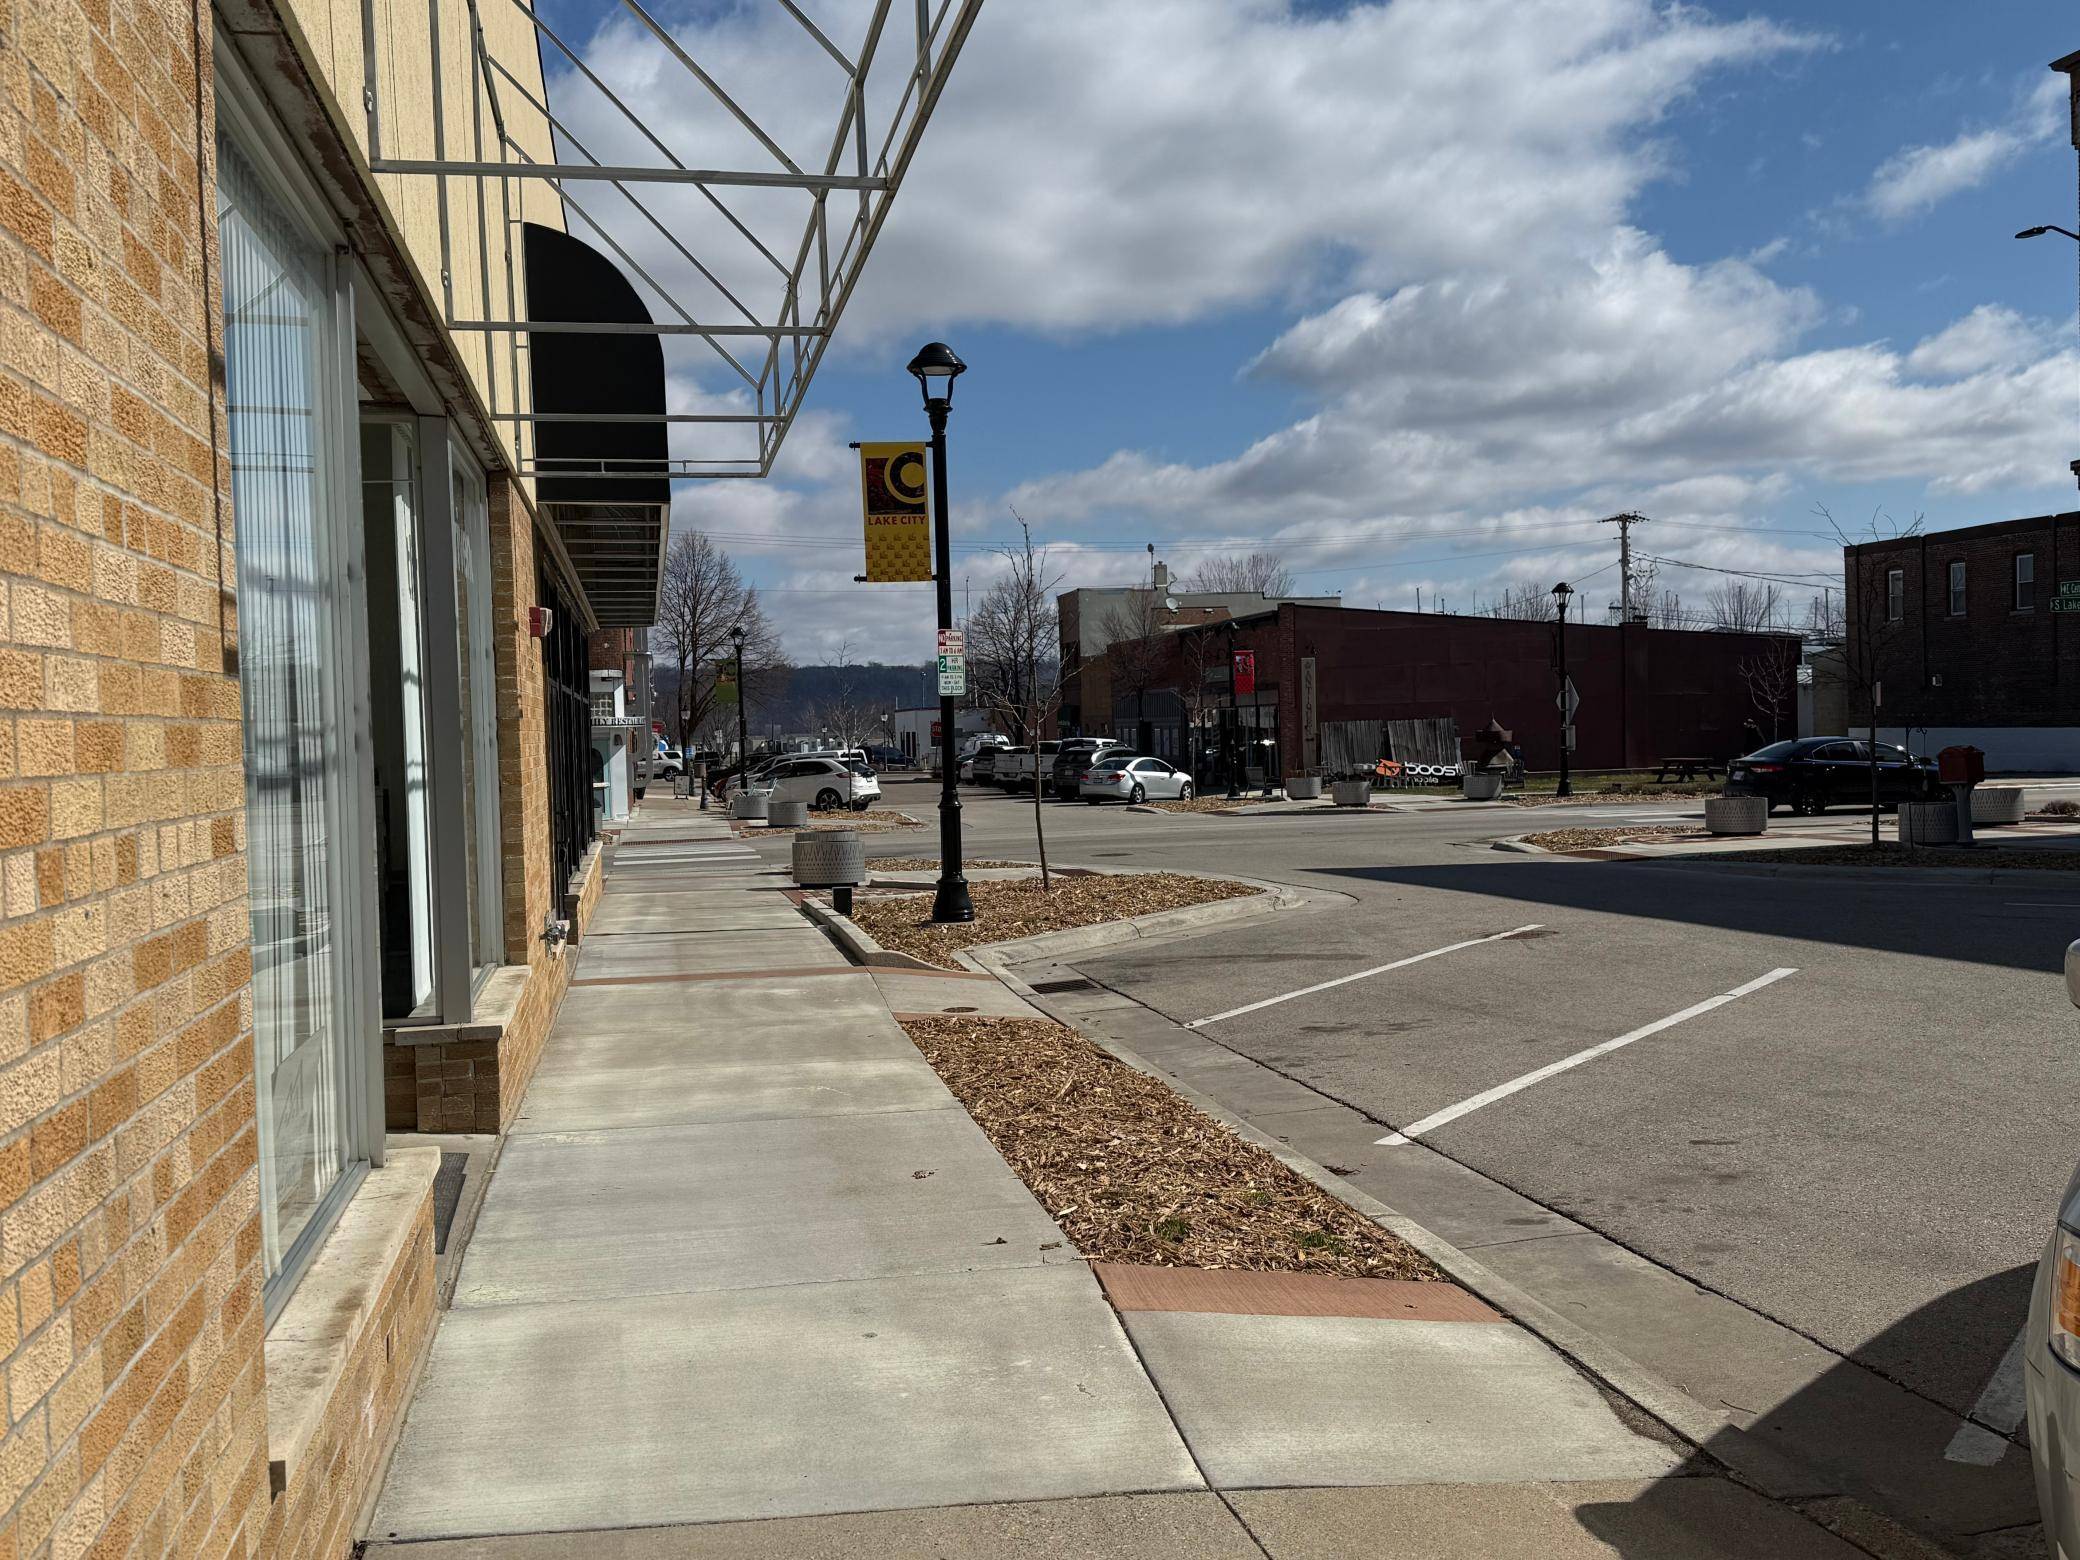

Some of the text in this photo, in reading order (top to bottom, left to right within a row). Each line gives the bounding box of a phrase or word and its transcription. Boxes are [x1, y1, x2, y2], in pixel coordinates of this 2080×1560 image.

[868, 516, 926, 525] LAKE CITY
[2054, 599, 2060, 610] S
[946, 634, 962, 642] PARKING
[940, 658, 946, 671] 2
[1405, 761, 1461, 776] boost
